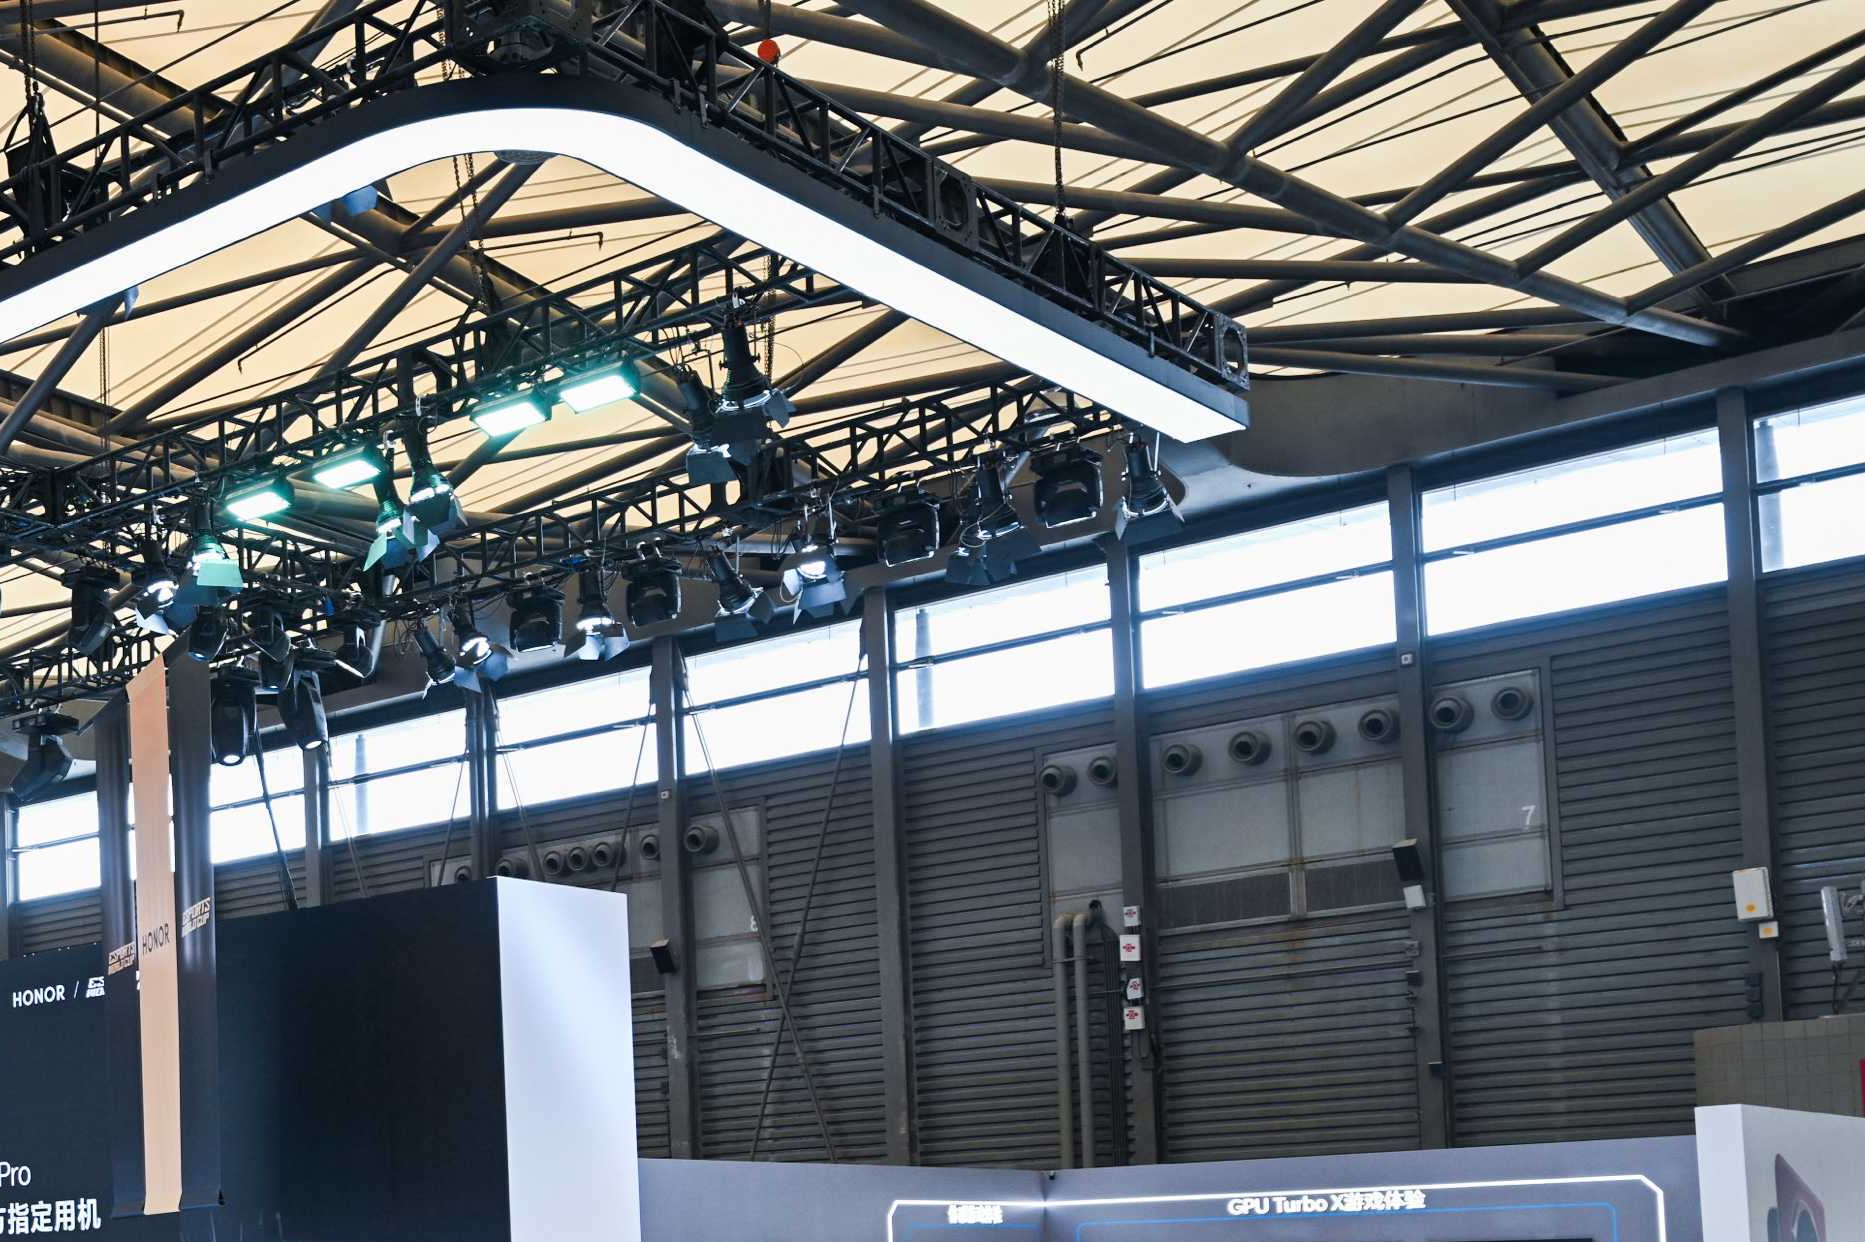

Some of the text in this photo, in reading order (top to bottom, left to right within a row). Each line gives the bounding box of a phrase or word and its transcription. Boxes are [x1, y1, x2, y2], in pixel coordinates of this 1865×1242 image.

[1521, 804, 1536, 830] 7
[142, 923, 171, 955] HONOR
[12, 984, 66, 1008] HONOR
[1227, 1197, 1269, 1215] GPU
[1272, 1195, 1328, 1214] Turbo
